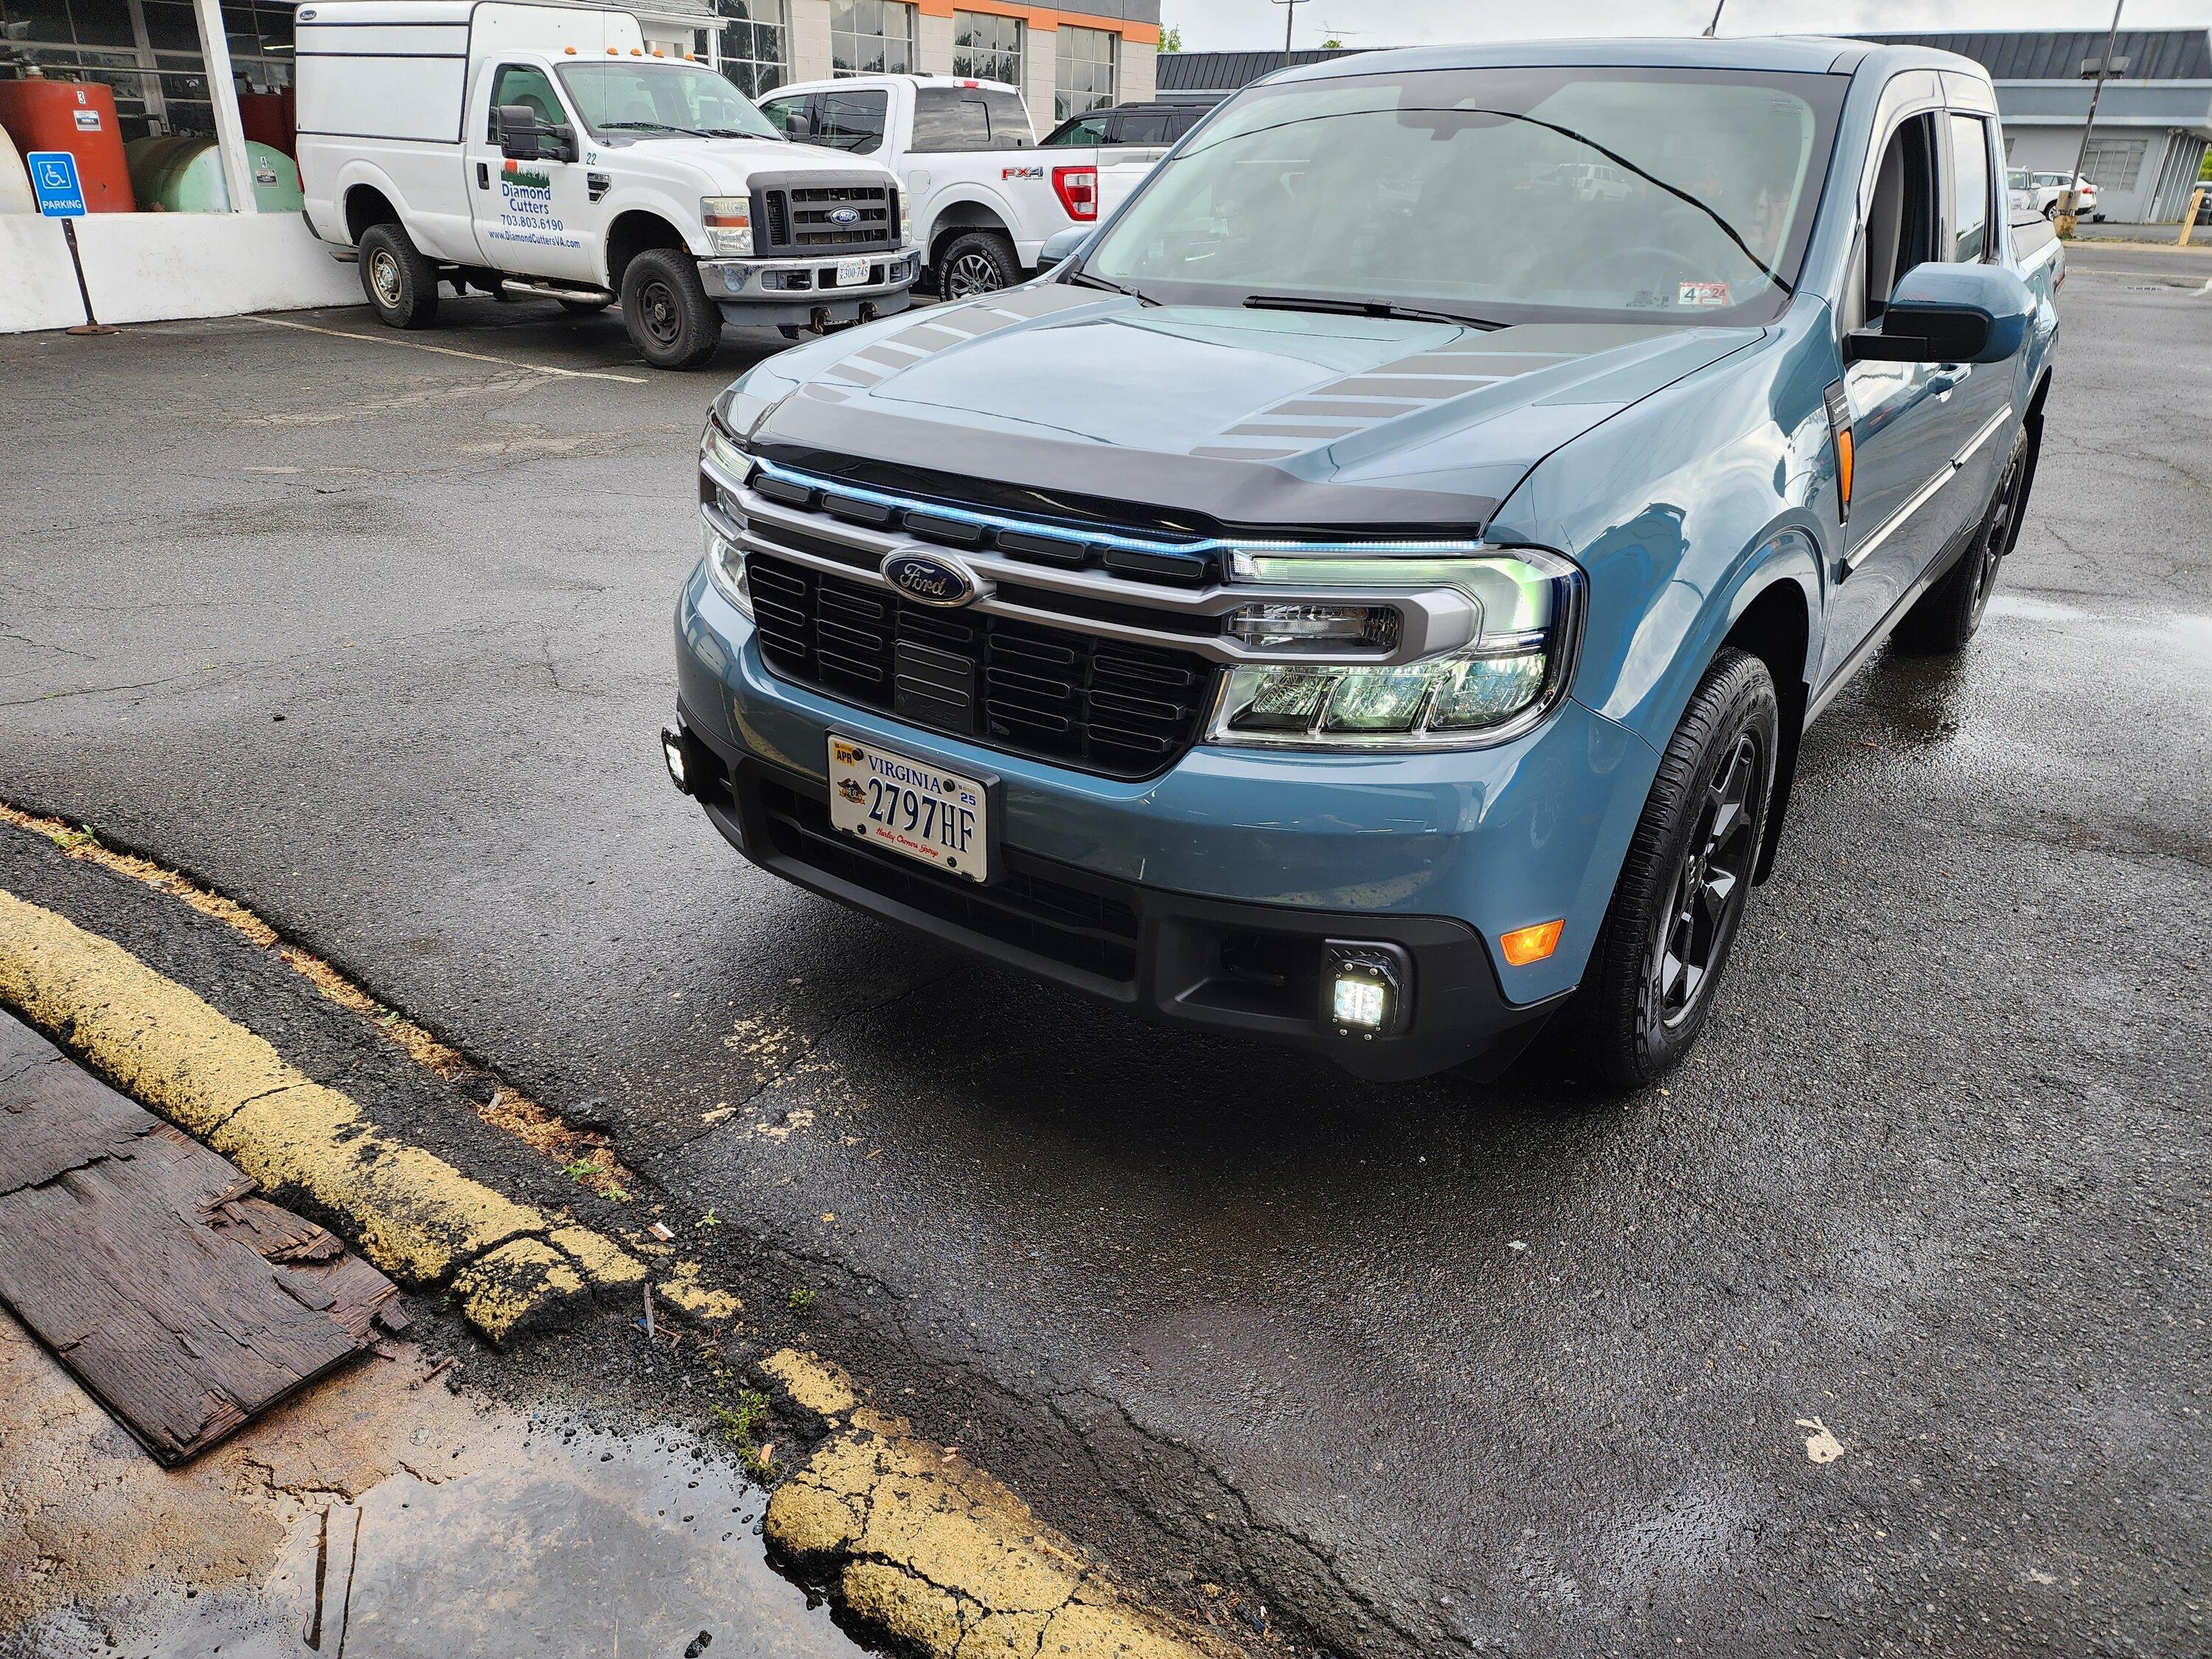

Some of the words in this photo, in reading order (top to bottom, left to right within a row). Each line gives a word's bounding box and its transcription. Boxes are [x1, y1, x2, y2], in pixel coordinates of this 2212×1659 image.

[78, 92, 84, 102] 3
[586, 152, 597, 165] 22
[1001, 166, 1043, 181] FX4
[502, 183, 552, 201] Diamond
[42, 199, 82, 209] PARKING
[509, 198, 549, 215] Cutters
[501, 214, 564, 231] 703.803.6190
[839, 212, 854, 220] Ford
[488, 231, 581, 249] www.DiamondCuttersVA.com
[1684, 288, 1696, 301] 4
[1712, 288, 1726, 298] 24
[900, 563, 947, 595] Ford
[837, 749, 852, 765] APR
[867, 754, 943, 795] VIRGINIA
[960, 792, 976, 806] 25
[867, 776, 976, 854] 2797HF
[875, 827, 896, 844] Harley
[897, 834, 919, 849] Owners
[919, 844, 939, 858] Group
